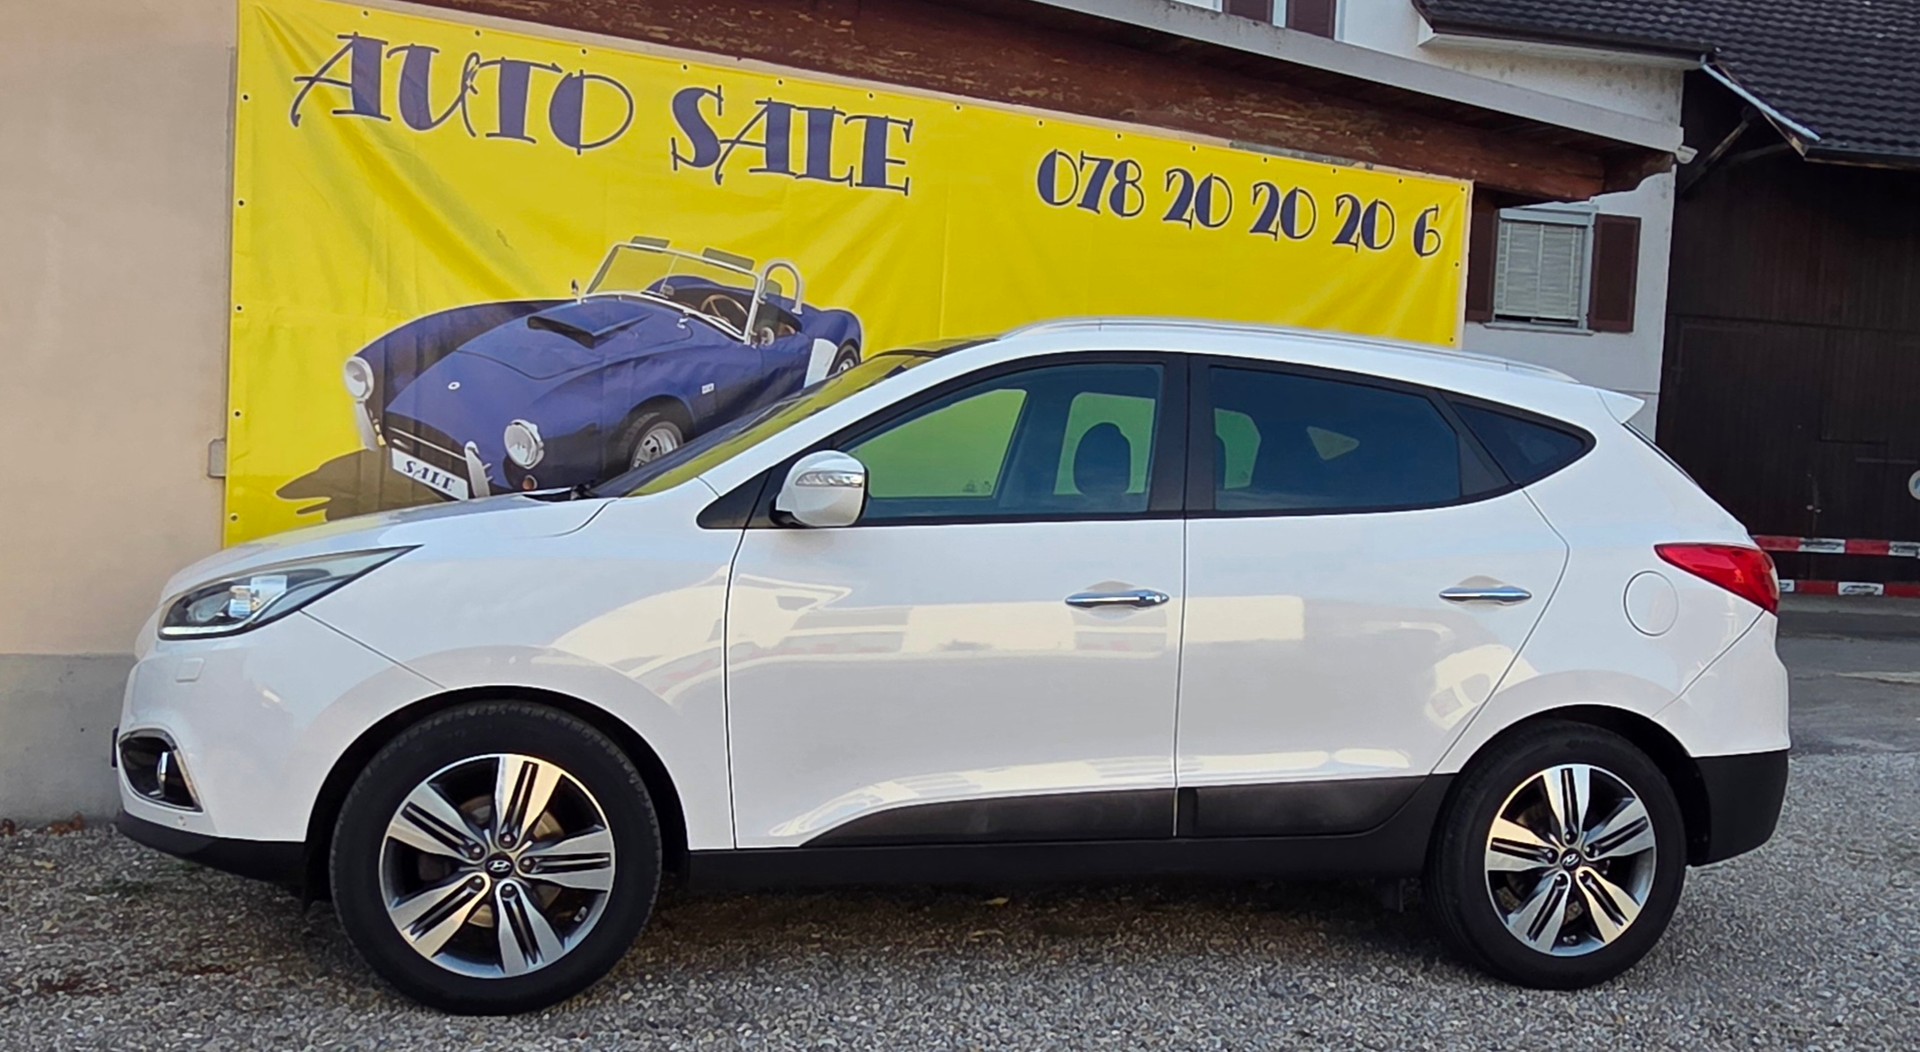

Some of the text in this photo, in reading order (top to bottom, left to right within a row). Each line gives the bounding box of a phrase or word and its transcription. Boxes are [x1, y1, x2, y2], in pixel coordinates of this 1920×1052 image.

[290, 31, 914, 196] AUTO SALE
[1037, 148, 1442, 257] 078 20 20 20 6
[403, 460, 455, 492] SALE
